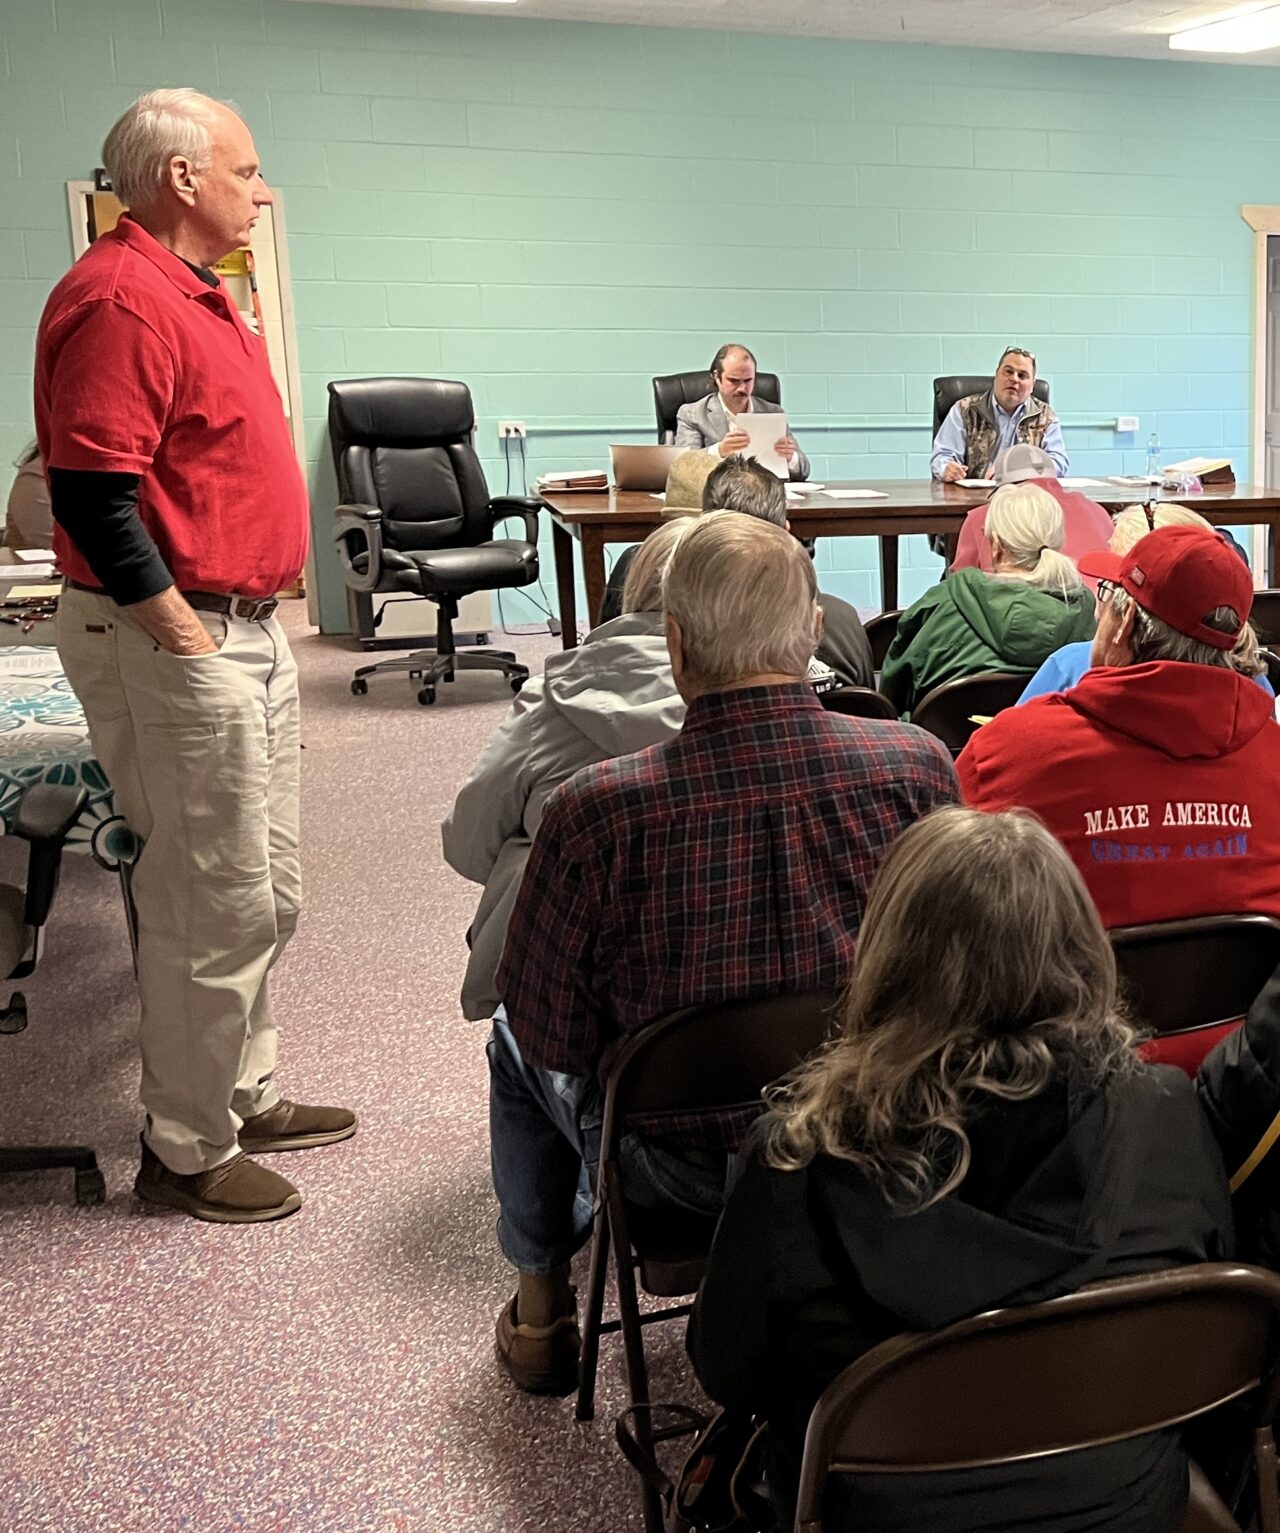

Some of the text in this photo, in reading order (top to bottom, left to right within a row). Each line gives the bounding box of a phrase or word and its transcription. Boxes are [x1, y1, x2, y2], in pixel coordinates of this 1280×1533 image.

[1084, 802, 1252, 835] MAKE AMERICA
[1091, 833, 1248, 863] GREAT AGAIN
